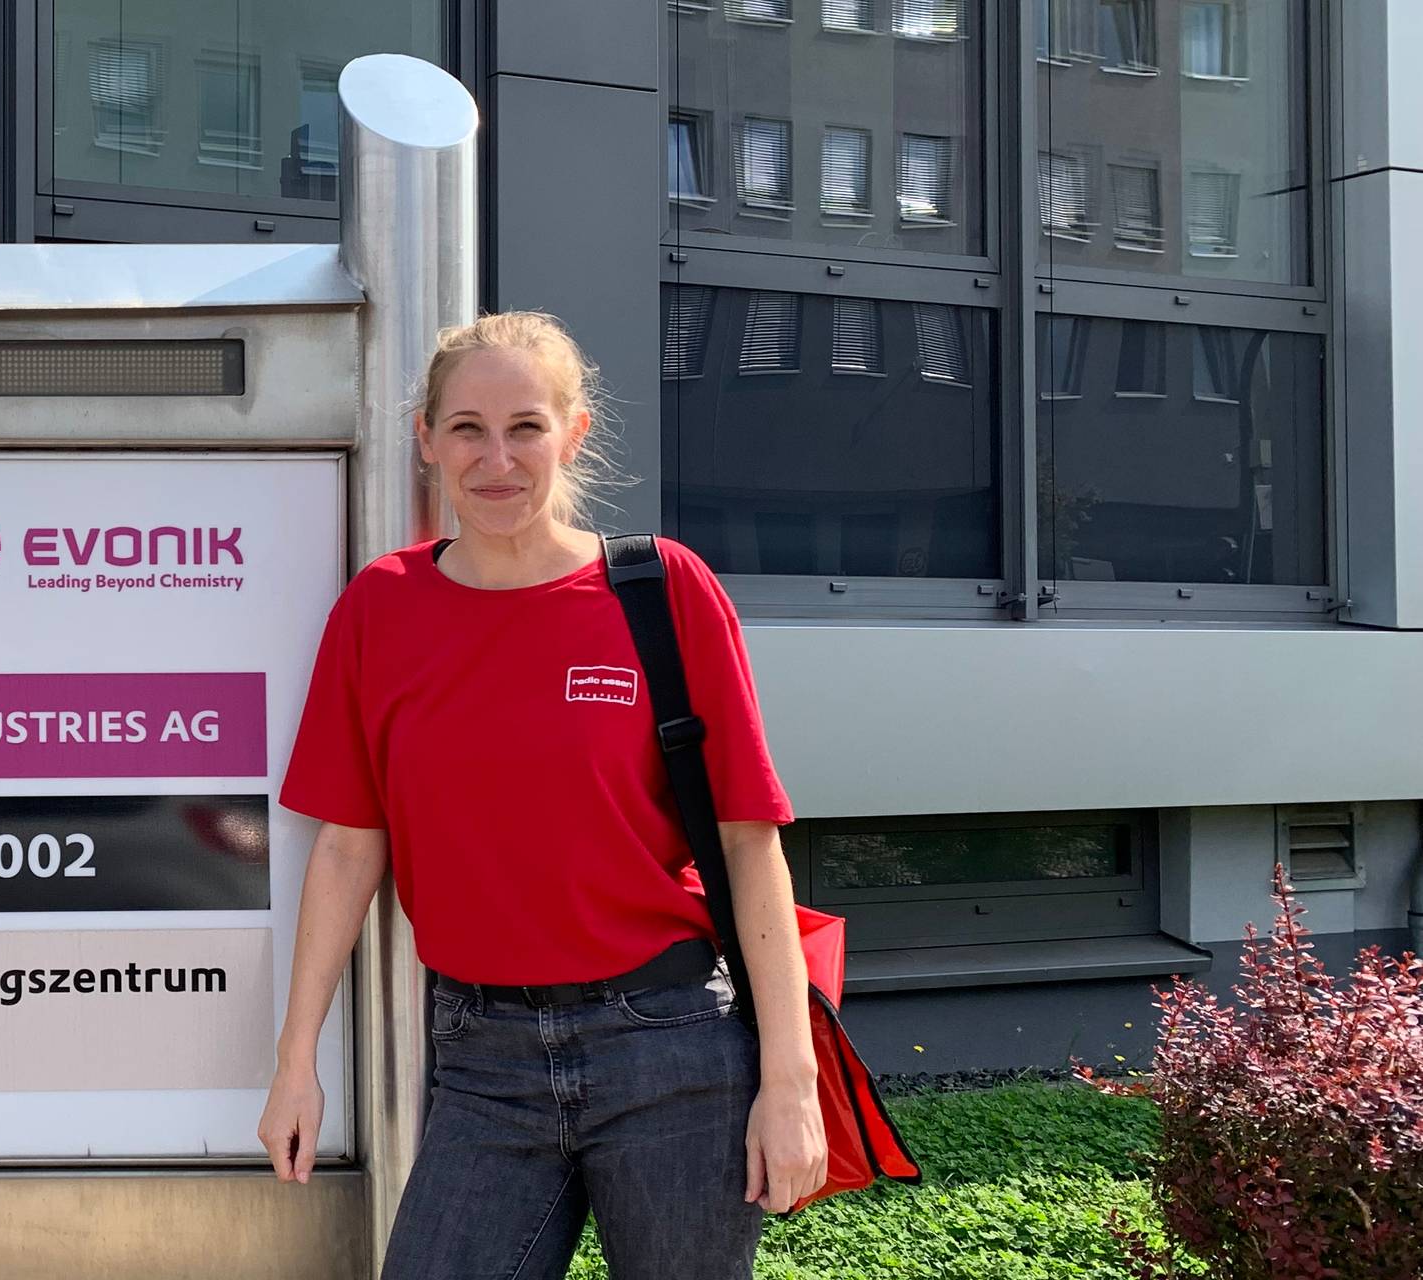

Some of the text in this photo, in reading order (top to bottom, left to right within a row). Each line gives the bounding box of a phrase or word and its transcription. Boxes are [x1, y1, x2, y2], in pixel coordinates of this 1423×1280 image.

[23, 526, 244, 567] EVONIK
[28, 572, 244, 593] Leading Beyond Chemistry
[159, 710, 219, 742] AG
